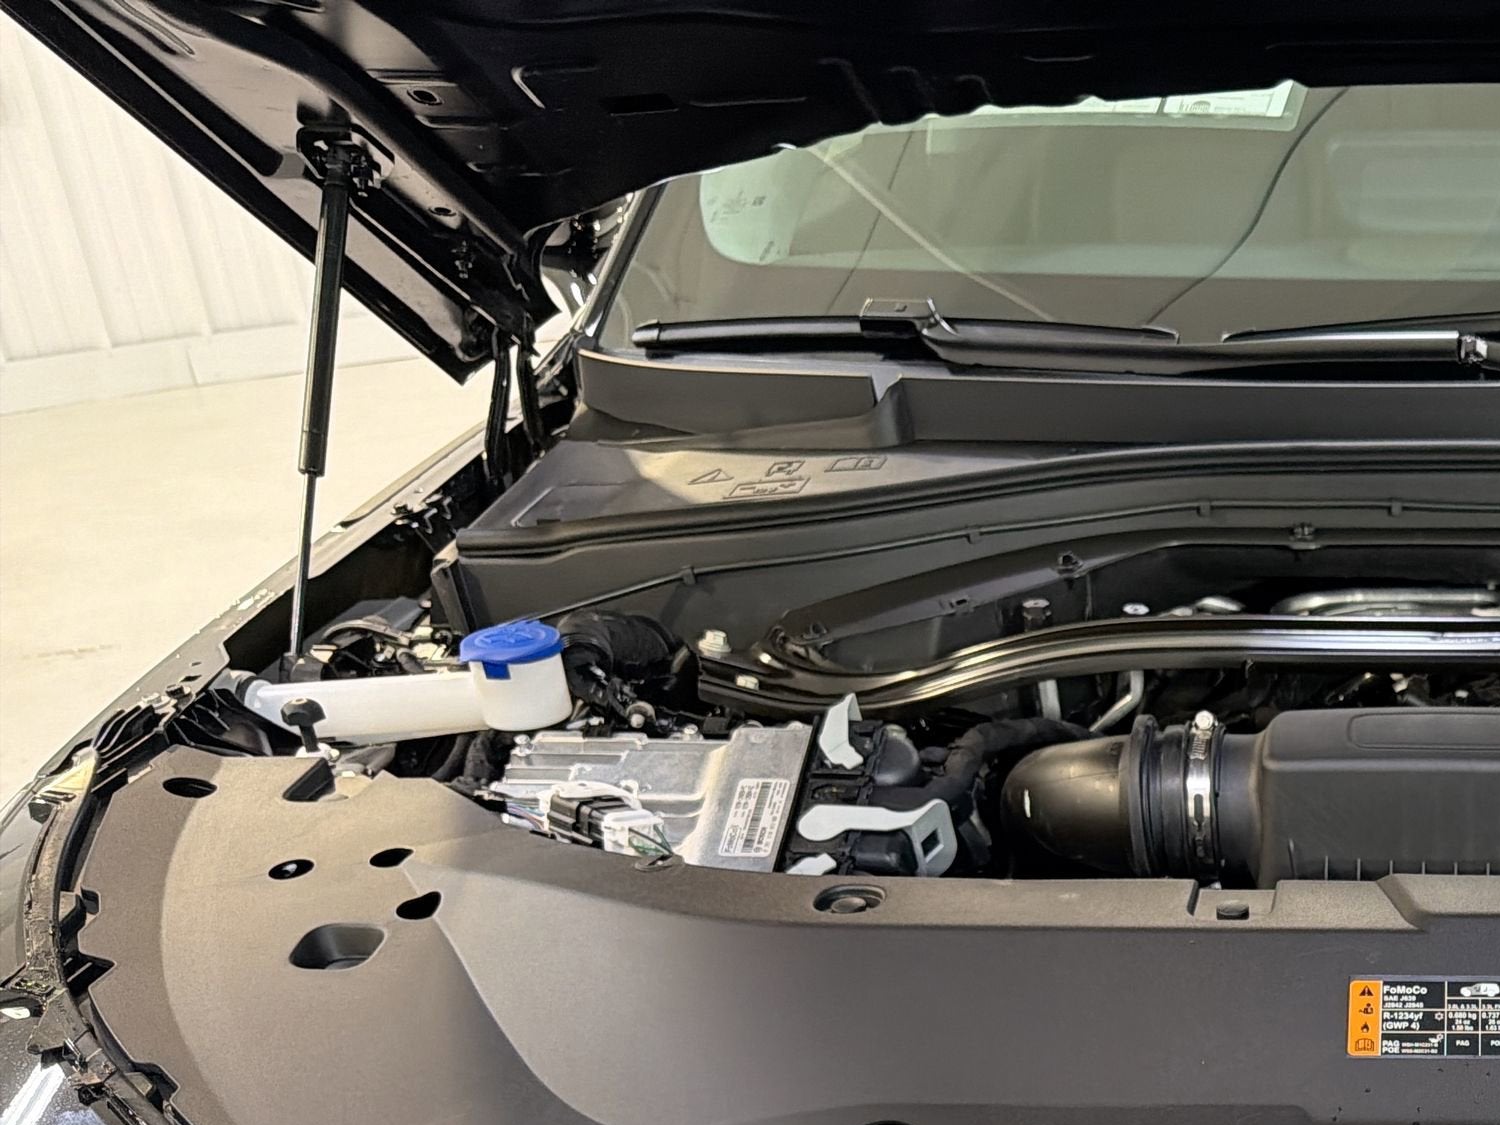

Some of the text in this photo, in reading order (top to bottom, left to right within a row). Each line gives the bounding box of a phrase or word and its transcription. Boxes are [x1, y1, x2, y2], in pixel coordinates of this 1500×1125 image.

[1383, 985, 1428, 995] FoMoCo
[1383, 1012, 1423, 1021] R-1234yf
[1468, 1012, 1477, 1020] kg
[1383, 1021, 1420, 1030] (GWP 4)
